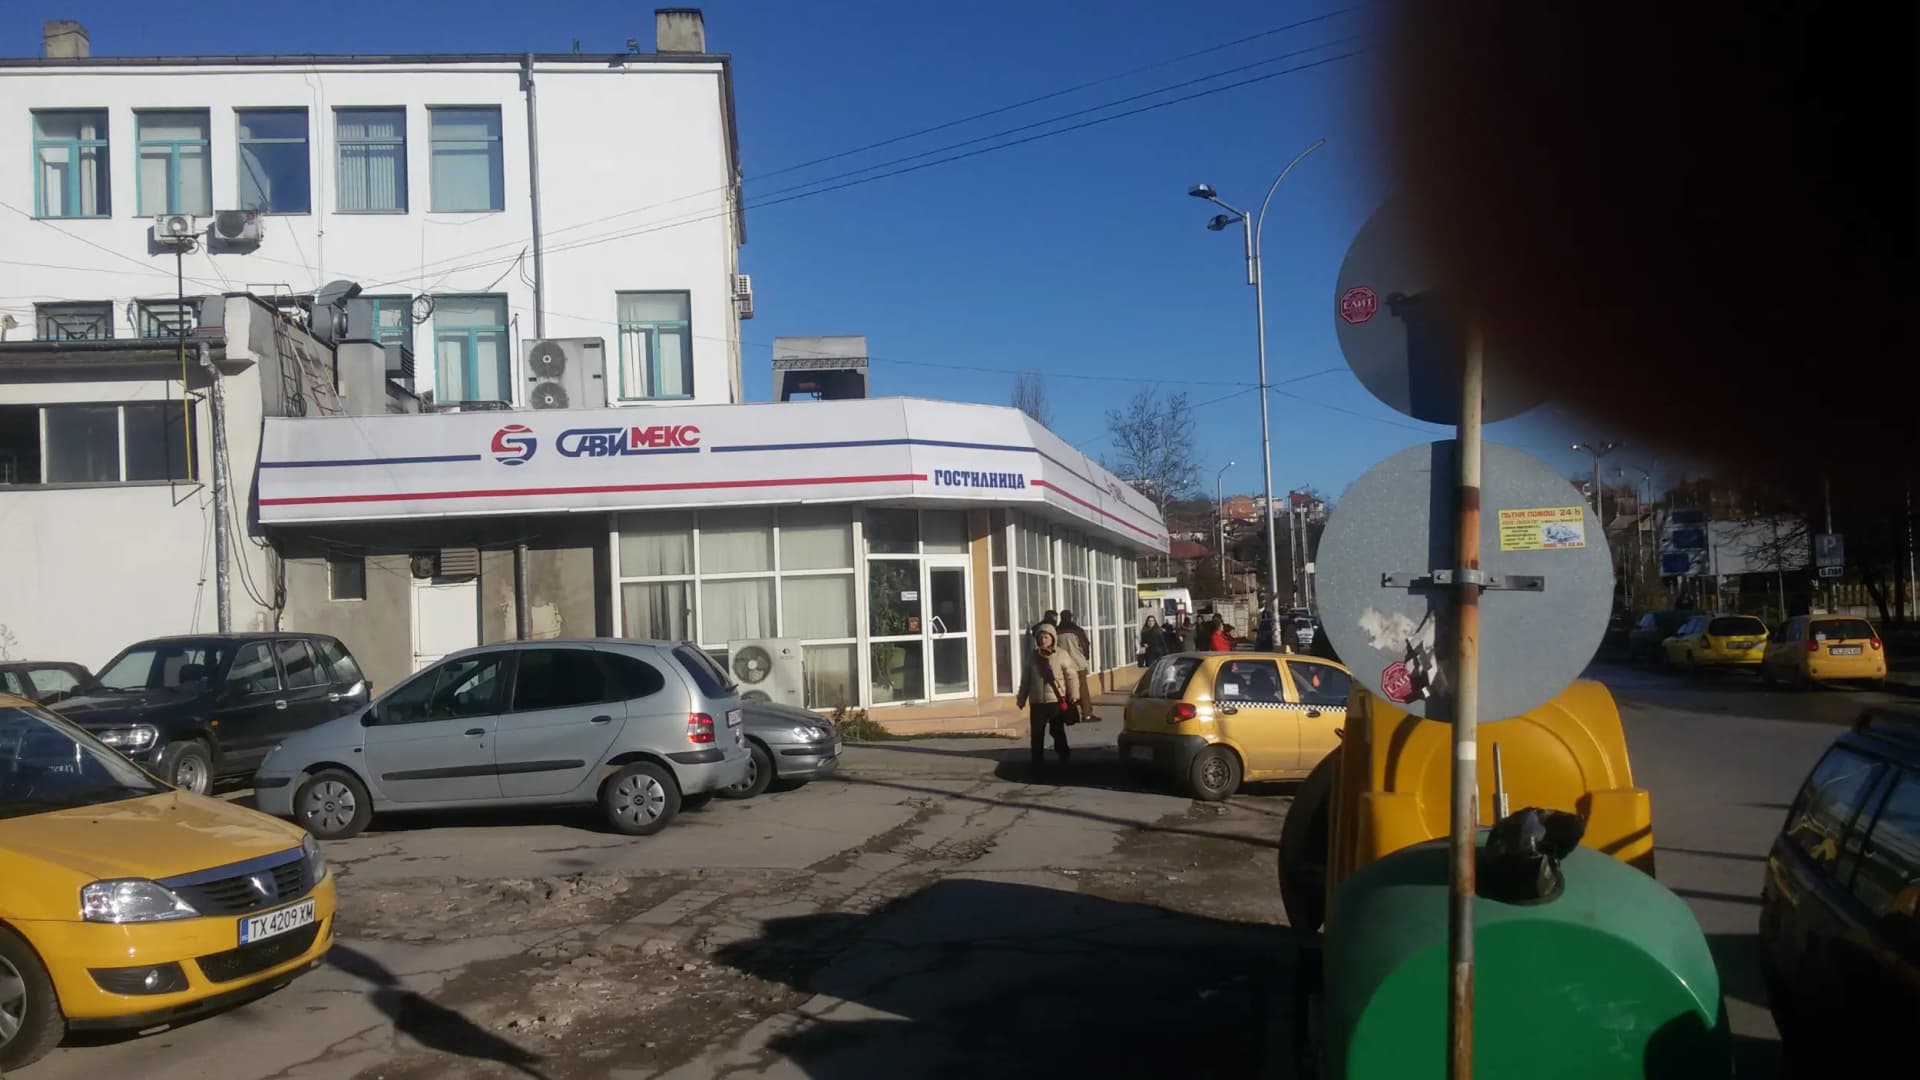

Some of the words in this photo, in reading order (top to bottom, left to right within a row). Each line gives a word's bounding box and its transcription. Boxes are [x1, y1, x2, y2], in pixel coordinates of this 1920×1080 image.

[934, 469, 1026, 490] ГОСТИЛНИЦА
[1559, 508, 1572, 516] 24
[251, 917, 268, 938] TX
[270, 909, 298, 932] 4209
